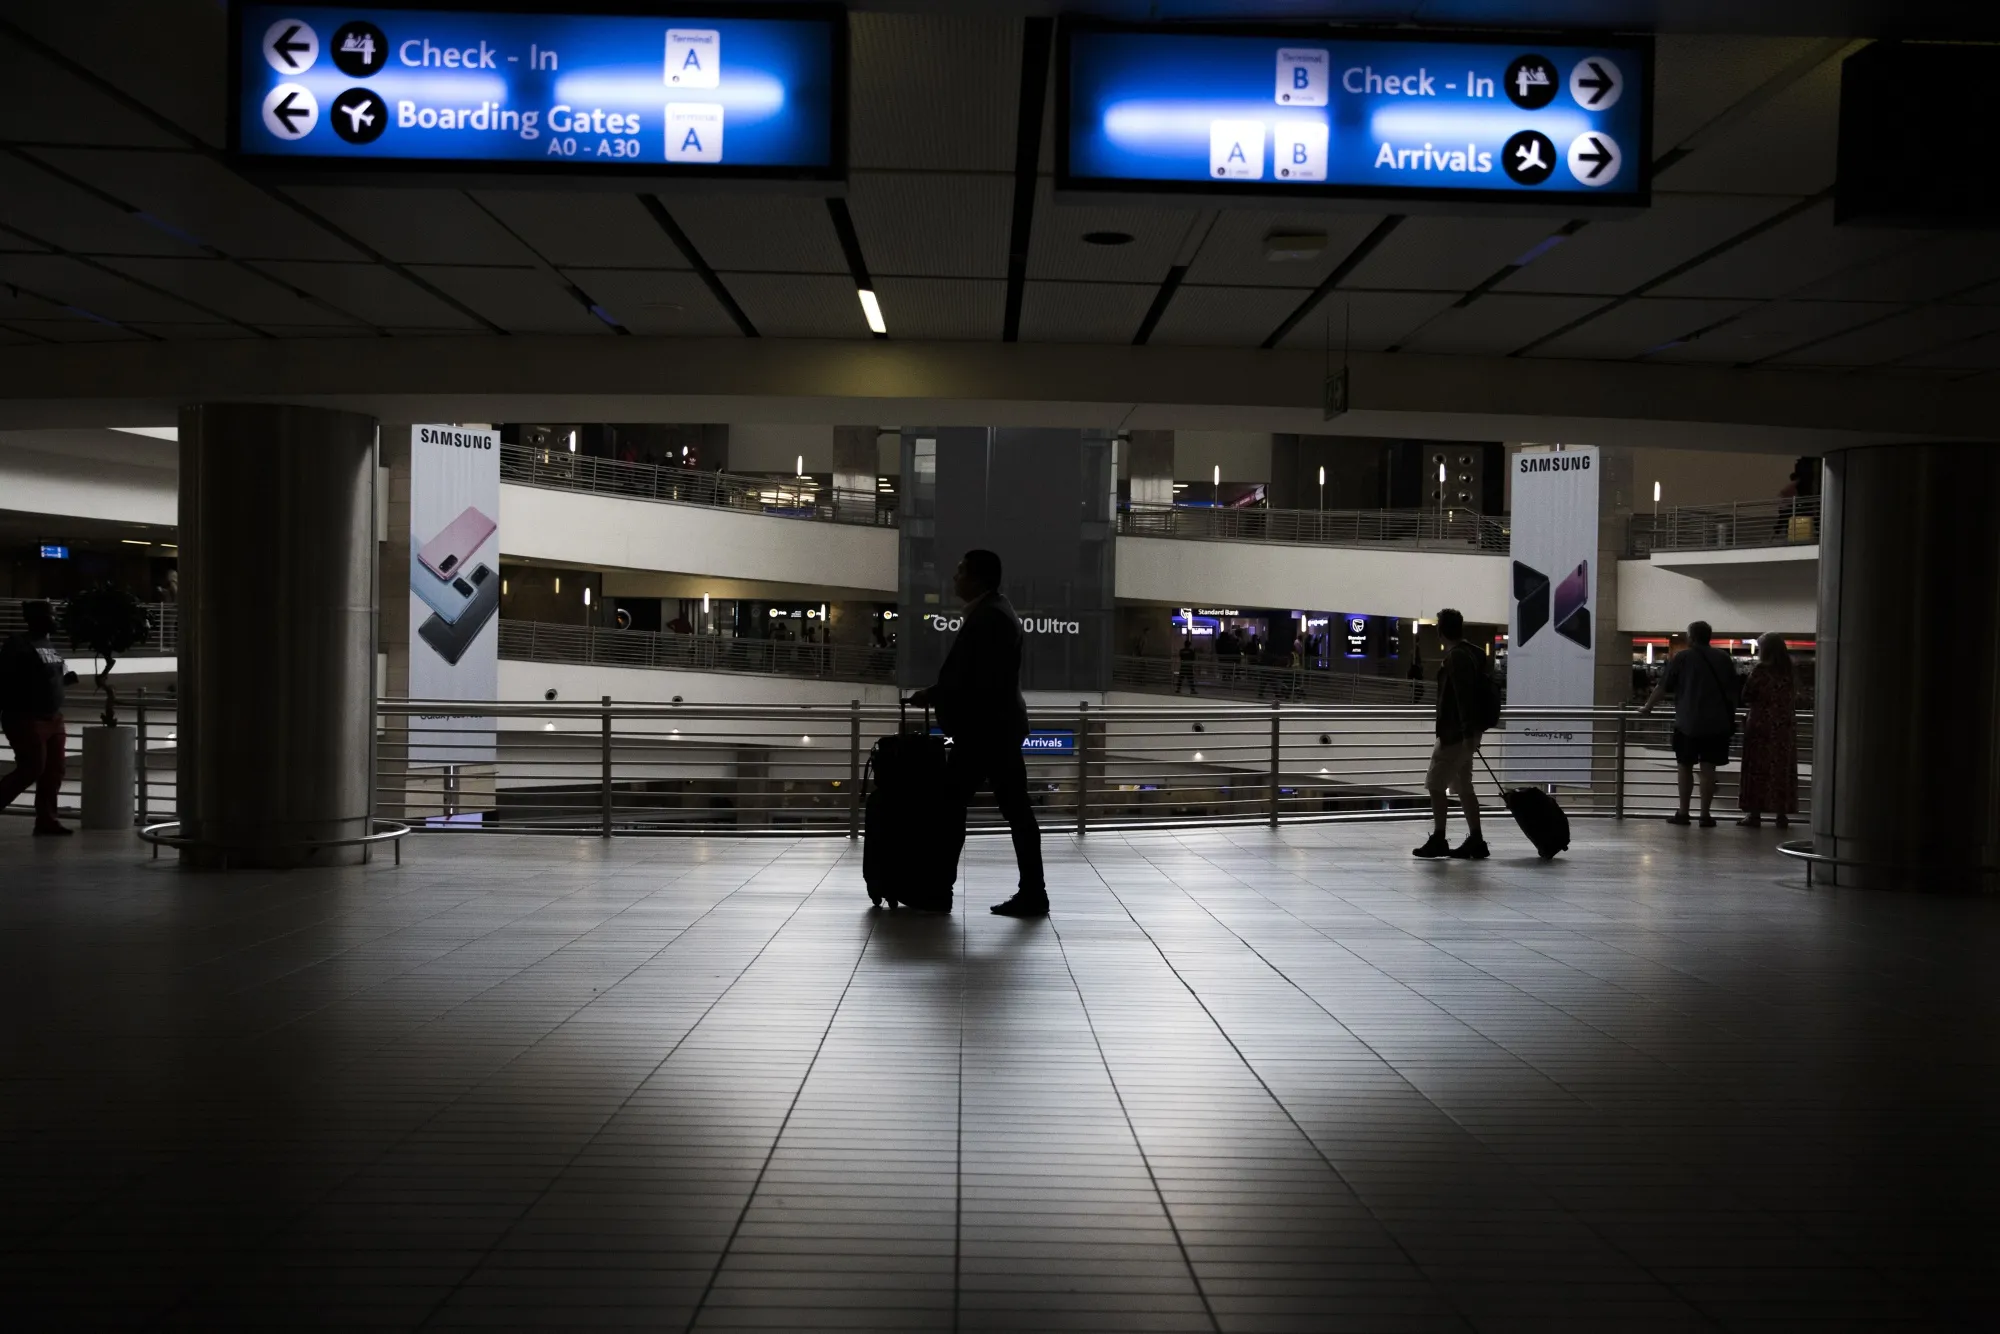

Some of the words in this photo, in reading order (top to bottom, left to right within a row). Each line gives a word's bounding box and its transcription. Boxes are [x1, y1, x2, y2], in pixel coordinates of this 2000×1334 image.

[672, 34, 713, 44] Terminal
[399, 38, 497, 69] Check
[530, 44, 558, 71] In
[682, 48, 701, 71] A
[1293, 67, 1309, 90] B
[1342, 66, 1436, 96] Check
[1467, 71, 1494, 98] In
[398, 100, 540, 140] Boarding
[547, 104, 641, 134] Gates
[547, 137, 577, 156] A0
[597, 138, 640, 158] A30
[681, 127, 702, 152] A
[1228, 141, 1246, 163] A
[1293, 143, 1308, 164] B
[1374, 142, 1493, 173] Arrivals
[421, 428, 492, 450] SAMSUNG
[1520, 455, 1590, 473] SAMSUNG
[1036, 618, 1080, 634] Ultra
[1022, 737, 1063, 748] Arrivals
